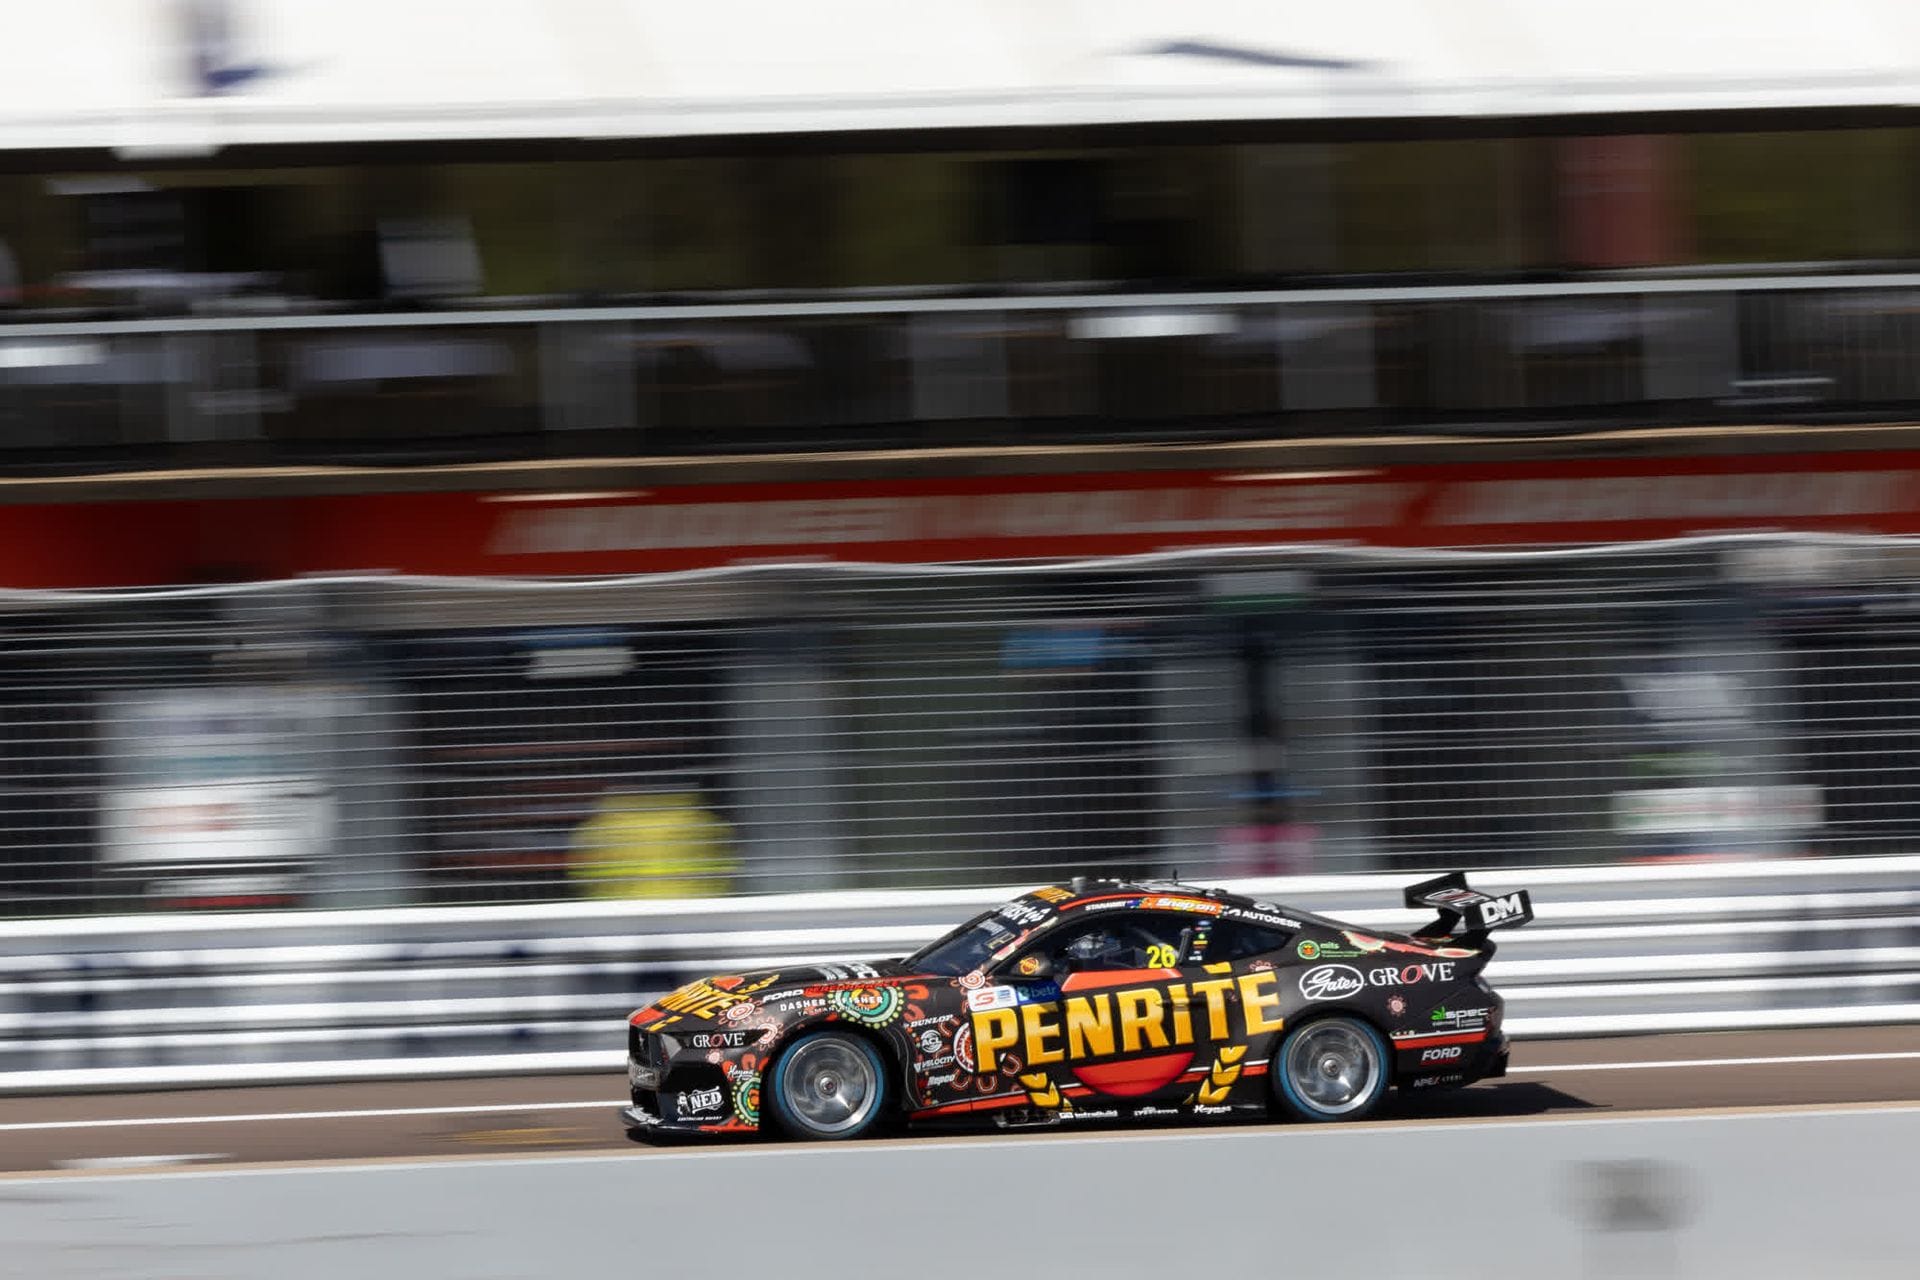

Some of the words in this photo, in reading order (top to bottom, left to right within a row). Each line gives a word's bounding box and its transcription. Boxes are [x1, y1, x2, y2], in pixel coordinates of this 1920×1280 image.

[1242, 911, 1302, 929] AUTODESK
[1146, 944, 1176, 968] 26
[1369, 962, 1454, 986] GROVE
[1304, 968, 1363, 999] Gates
[762, 989, 804, 1003] FORD
[780, 998, 826, 1012] DASHER
[842, 995, 884, 1005] FISHER
[911, 1014, 953, 1027] DUNLOP
[970, 970, 1284, 1073] PENRITE
[1431, 1006, 1489, 1027] alspec
[693, 1033, 744, 1048] GROVE
[922, 1036, 942, 1047] ACL
[1422, 1047, 1462, 1061] FORD
[691, 1092, 723, 1109] NED
